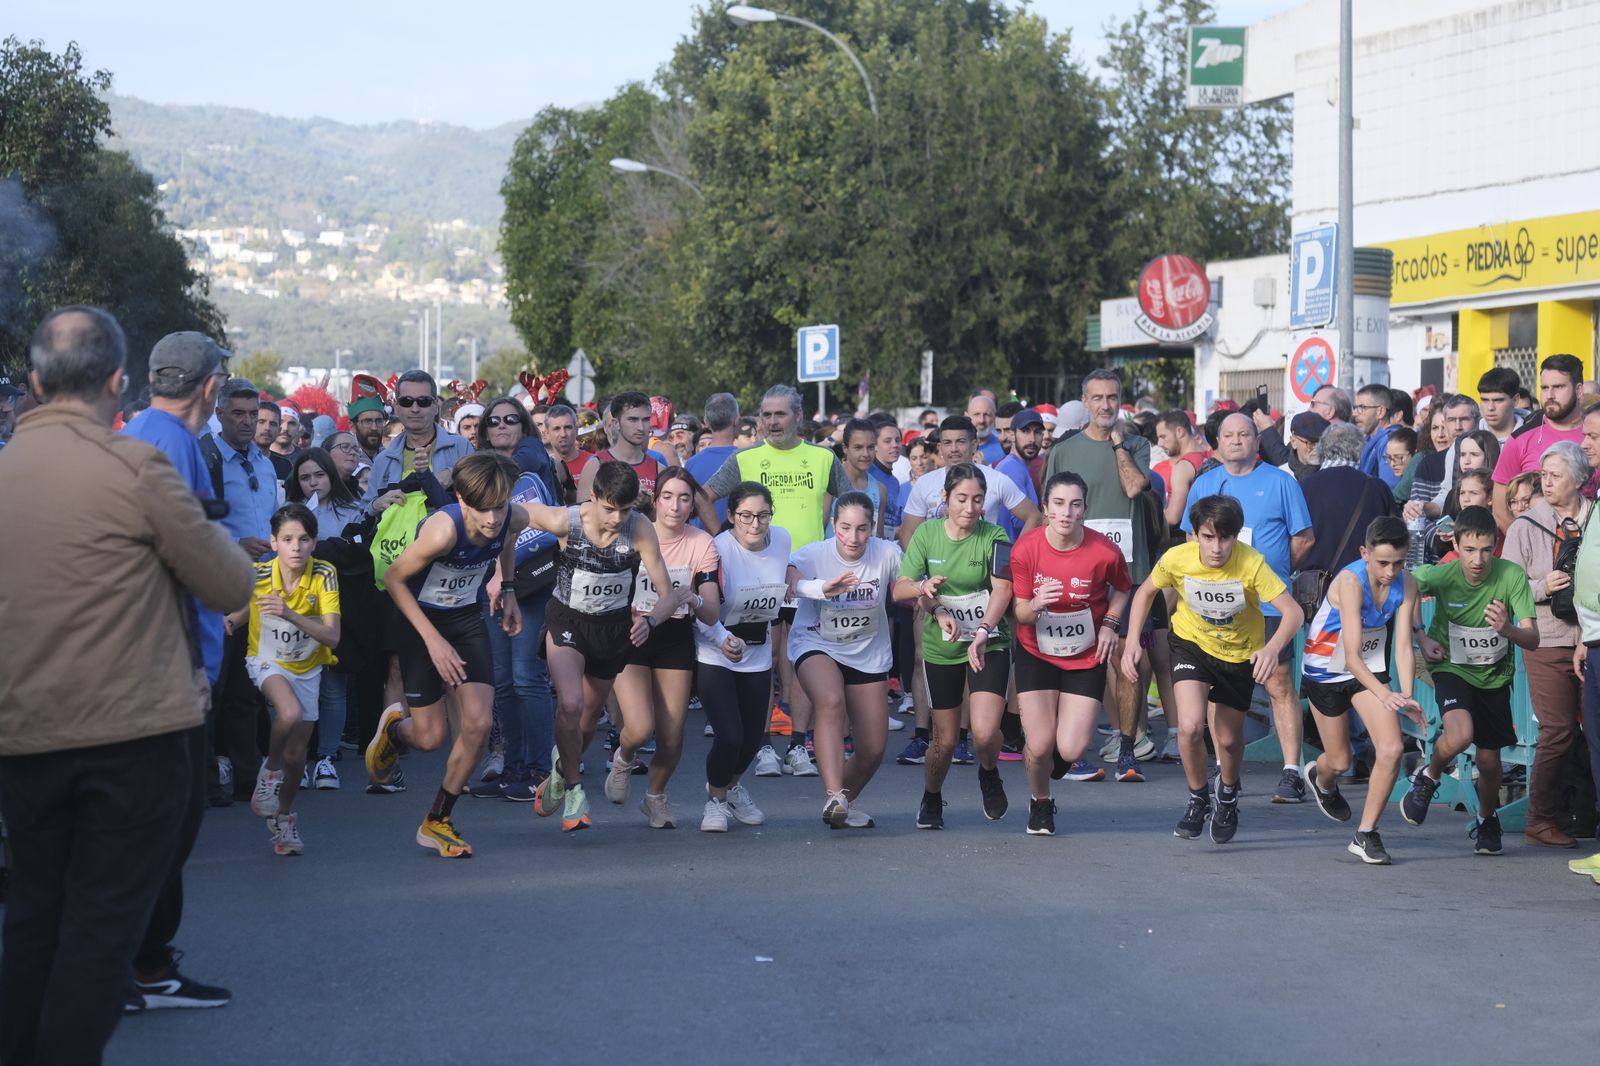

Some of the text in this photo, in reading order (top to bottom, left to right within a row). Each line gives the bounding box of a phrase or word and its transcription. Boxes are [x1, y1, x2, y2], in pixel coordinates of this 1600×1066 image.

[1393, 244, 1448, 284] rcados
[1298, 240, 1325, 316] P
[805, 333, 829, 375] P
[440, 575, 477, 590] 1067
[583, 584, 623, 596] 1050
[1195, 590, 1235, 603] 1065
[743, 597, 777, 610] 1020
[948, 606, 985, 621] 1016
[831, 616, 871, 628] 1022
[1046, 624, 1085, 637] 1120
[1361, 638, 1380, 652] 86
[1460, 637, 1499, 648] 1030
